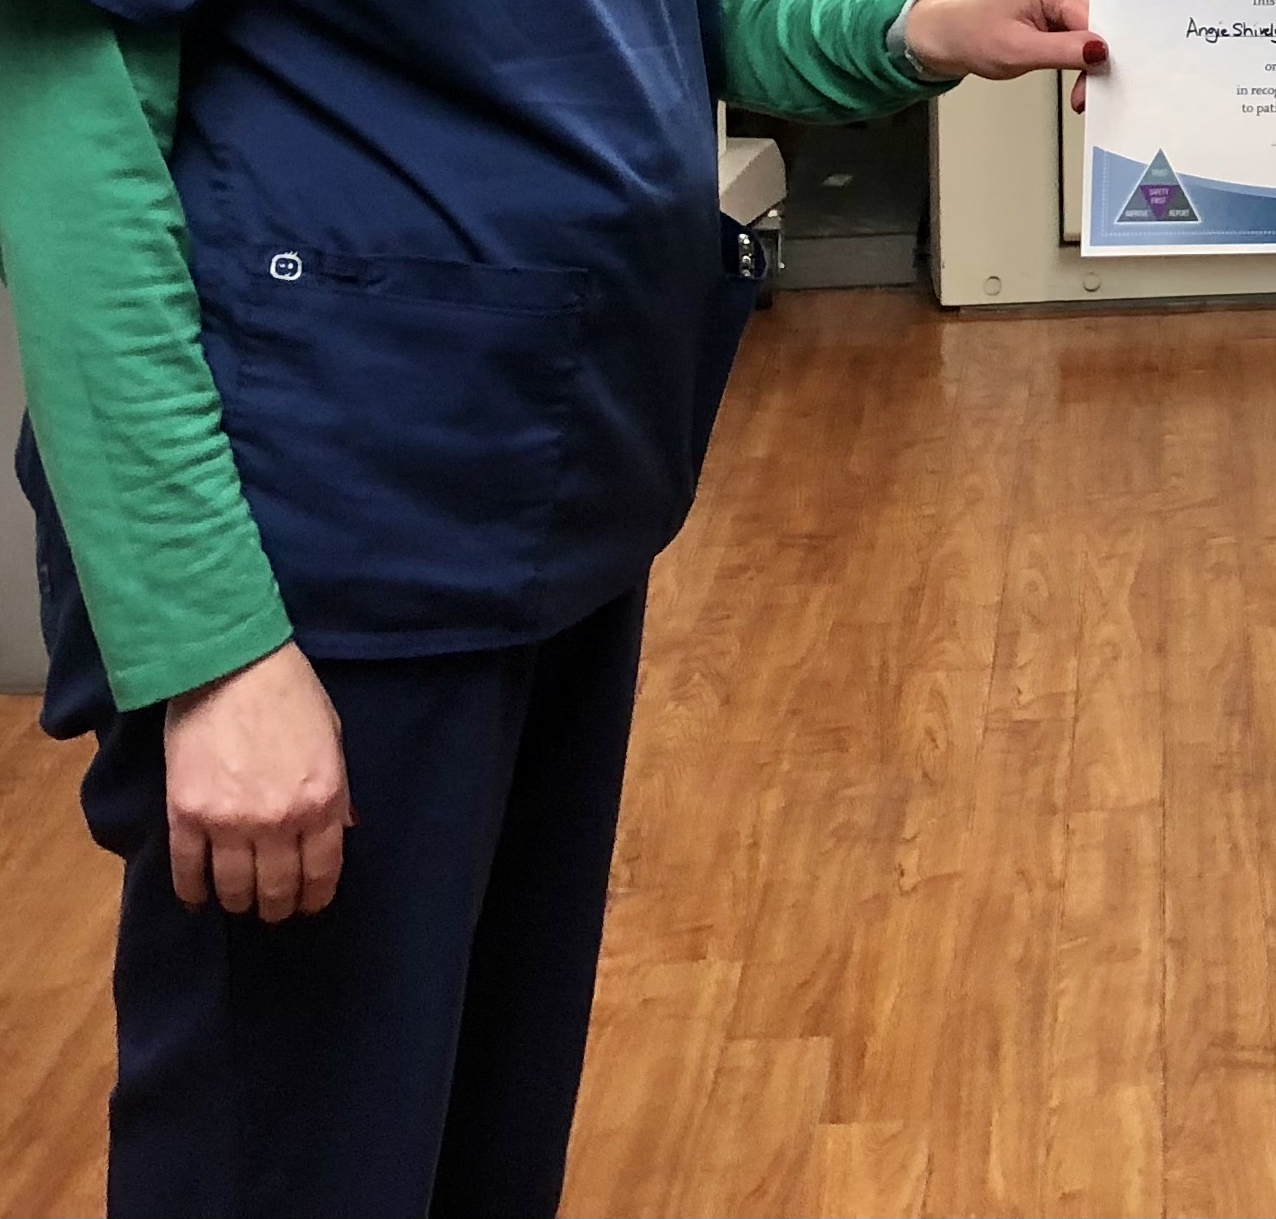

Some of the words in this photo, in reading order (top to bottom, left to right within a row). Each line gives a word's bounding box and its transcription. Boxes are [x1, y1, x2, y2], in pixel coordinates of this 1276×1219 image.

[1186, 17, 1230, 43] Angie
[1236, 84, 1248, 95] in
[1242, 104, 1254, 113] to
